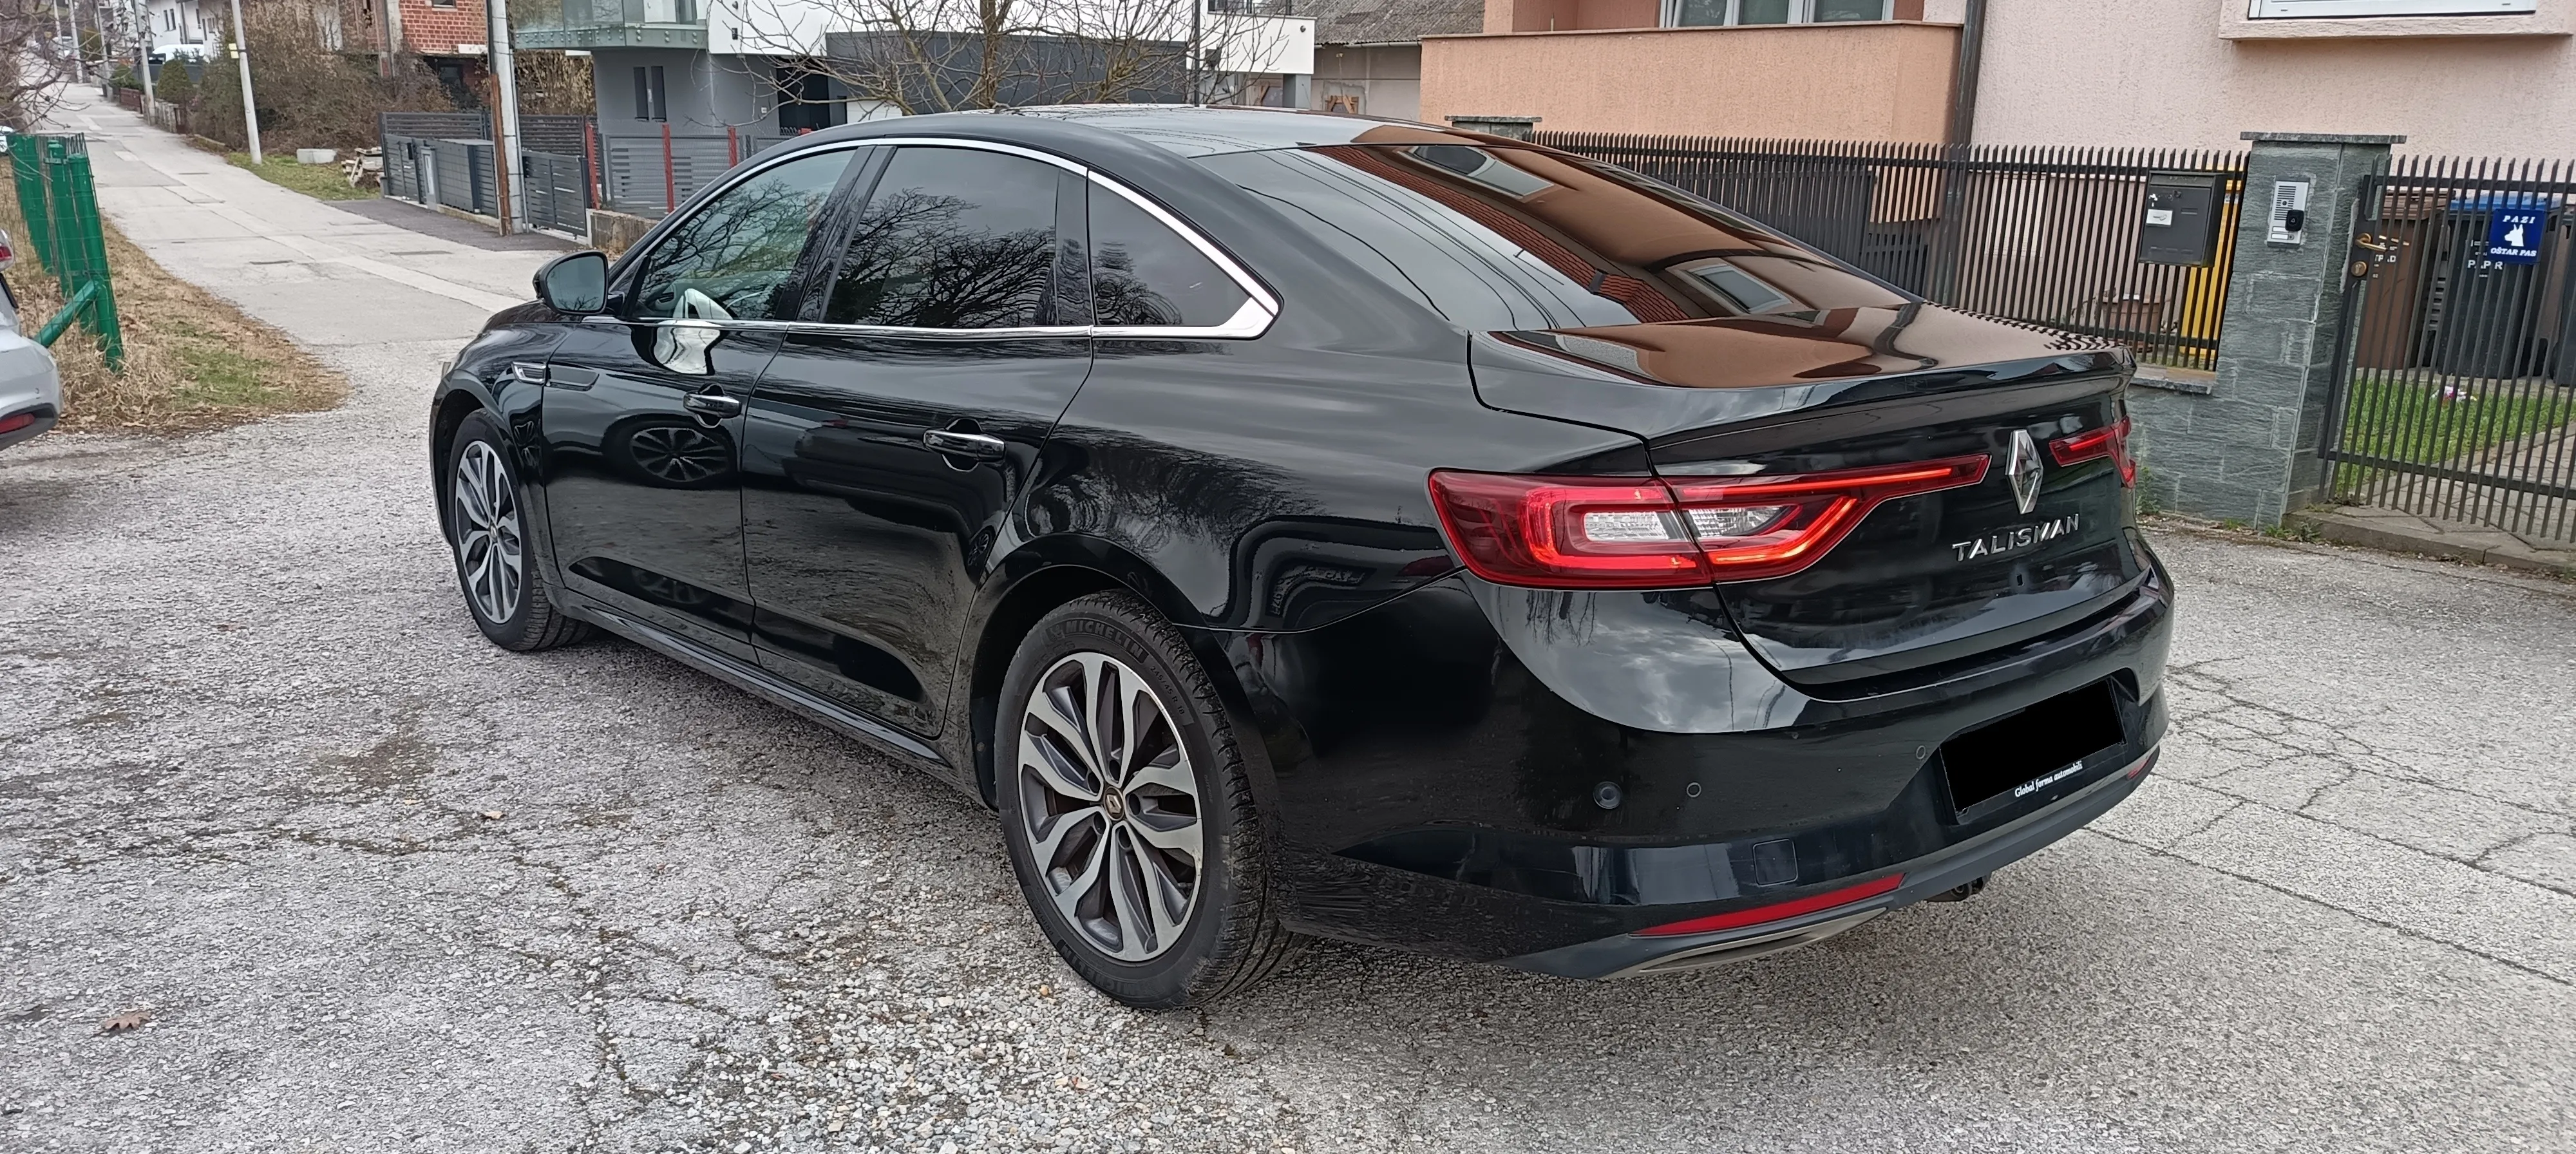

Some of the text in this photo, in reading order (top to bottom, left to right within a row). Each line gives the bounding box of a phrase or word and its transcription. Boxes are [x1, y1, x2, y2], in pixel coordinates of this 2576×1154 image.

[2503, 215, 2535, 223] PAZI
[2467, 260, 2503, 270] PPR
[2490, 247, 2518, 255] OŠTAR
[1952, 513, 2079, 562] TALISMAN
[1065, 620, 1144, 659] MICHELIN
[1150, 666, 1173, 694] 245/45
[1177, 705, 1185, 715] 18
[2014, 760, 2083, 797] Global forma automobili
[1030, 898, 1054, 935] PRIMACY
[1061, 942, 1137, 996] MICHELIN
